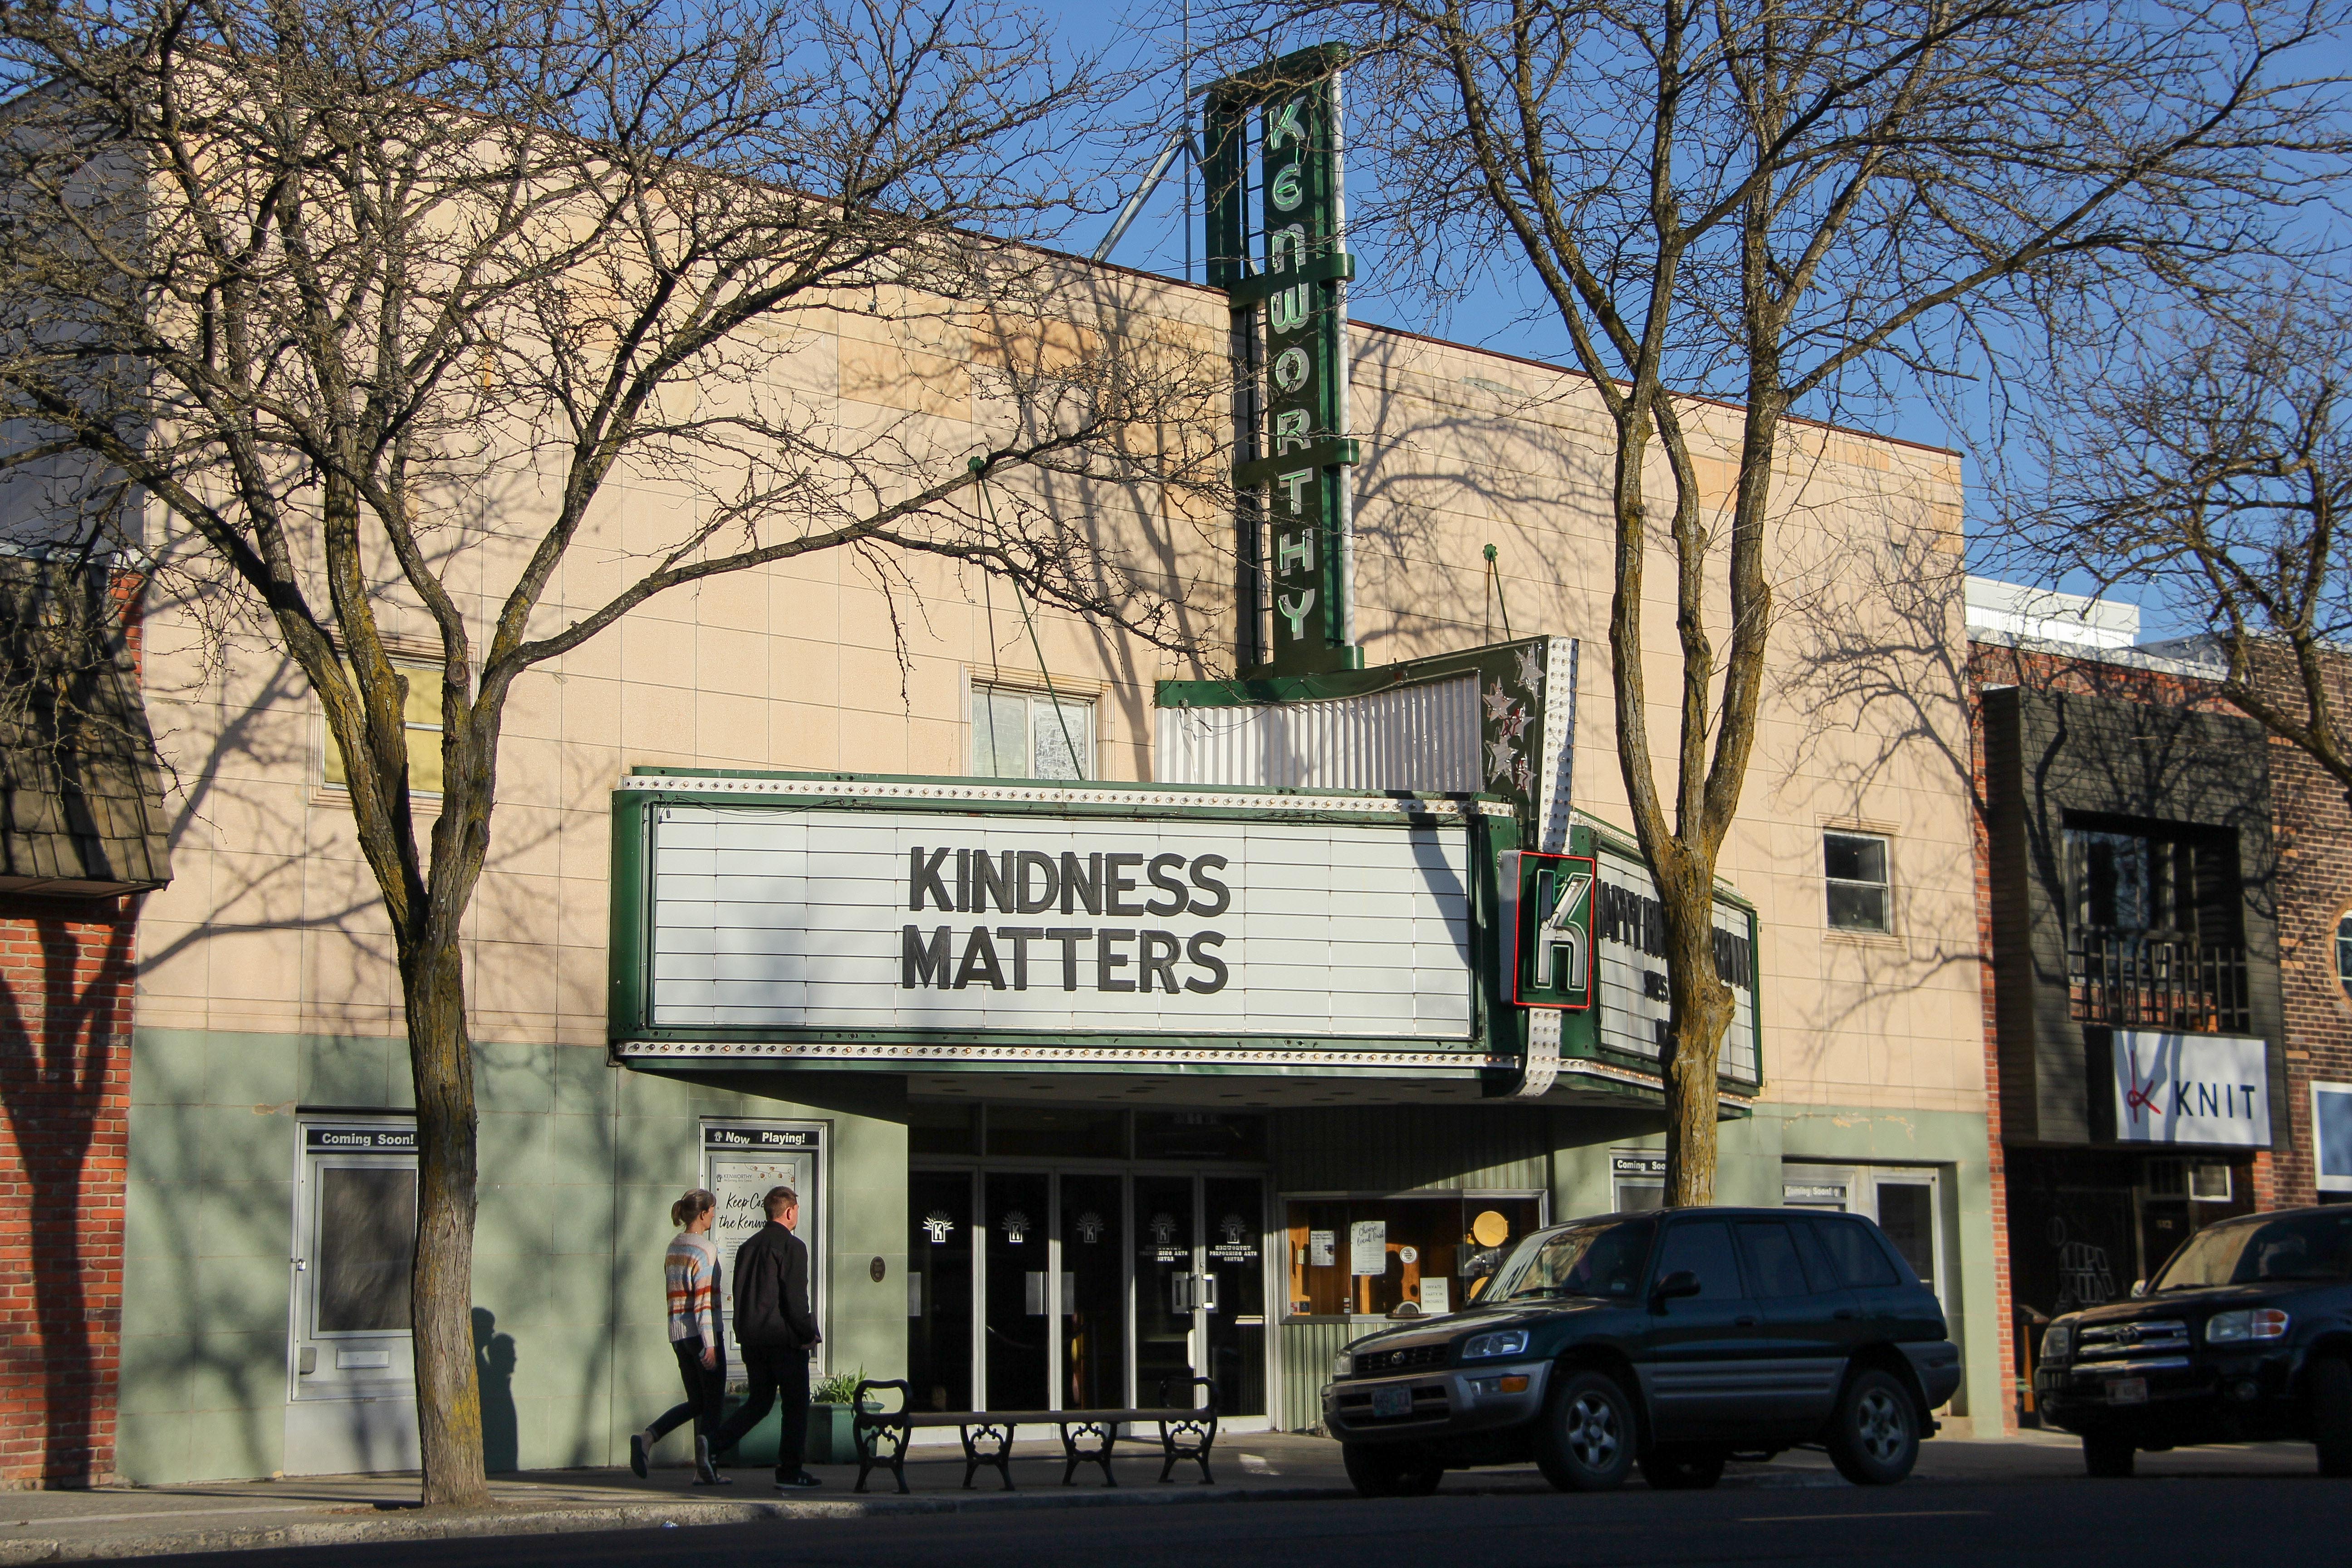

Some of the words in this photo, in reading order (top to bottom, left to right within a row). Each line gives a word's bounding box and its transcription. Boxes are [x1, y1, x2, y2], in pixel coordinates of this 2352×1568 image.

[909, 847, 1230, 917] KINDNESS
[1534, 869, 1593, 991] K
[902, 925, 1229, 994] MATTERS
[2174, 1079, 2255, 1120] KNIT
[322, 1132, 371, 1146] Coming
[378, 1134, 414, 1145] Soon!
[725, 1132, 750, 1144] Now
[762, 1132, 806, 1145] Playing!
[1617, 1160, 1646, 1171] Coming
[1651, 1161, 1666, 1170] Soo
[1786, 1186, 1810, 1197] Coming
[726, 1192, 749, 1211] Keep
[719, 1214, 736, 1228] the
[1359, 1225, 1377, 1236] Choose
[1357, 1234, 1371, 1246] local
